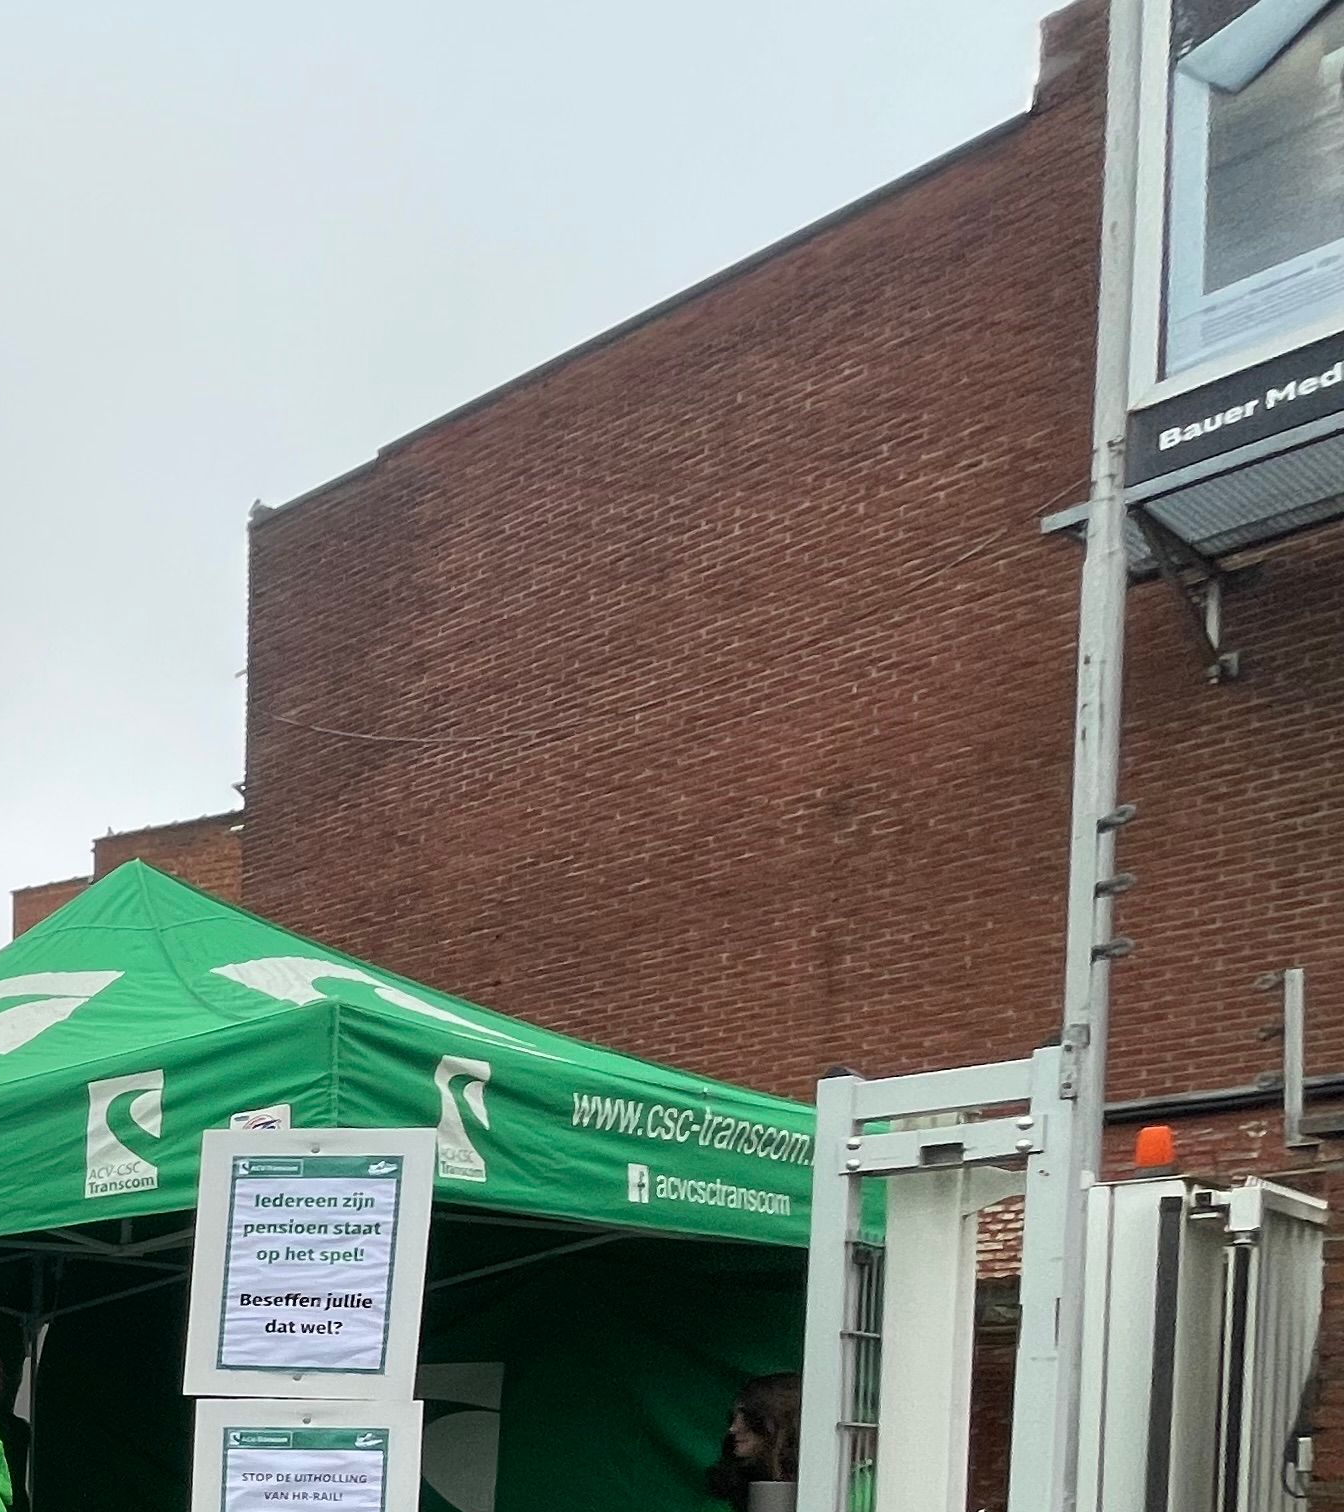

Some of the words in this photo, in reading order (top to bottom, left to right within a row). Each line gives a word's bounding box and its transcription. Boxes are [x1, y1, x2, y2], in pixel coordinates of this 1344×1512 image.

[1160, 399, 1260, 451] Bauer
[572, 1093, 815, 1166] www.csc-transcom.
[87, 1174, 155, 1195] Transcom
[254, 1193, 338, 1209] Iedereen
[342, 1191, 376, 1211] zijn
[655, 1172, 791, 1217] acvcsctranscom
[243, 1218, 329, 1237] pensioen
[332, 1221, 382, 1236] staat
[256, 1249, 280, 1265] op
[284, 1247, 316, 1262] het
[319, 1247, 365, 1265] spel!
[239, 1293, 322, 1309] Beseffen
[324, 1292, 374, 1311] jullie
[265, 1319, 296, 1335] dat
[300, 1320, 344, 1336] wel?
[241, 1472, 273, 1482] STOP
[276, 1473, 291, 1482] DE
[294, 1473, 368, 1484] UITHOLLING
[264, 1491, 289, 1501] VAN
